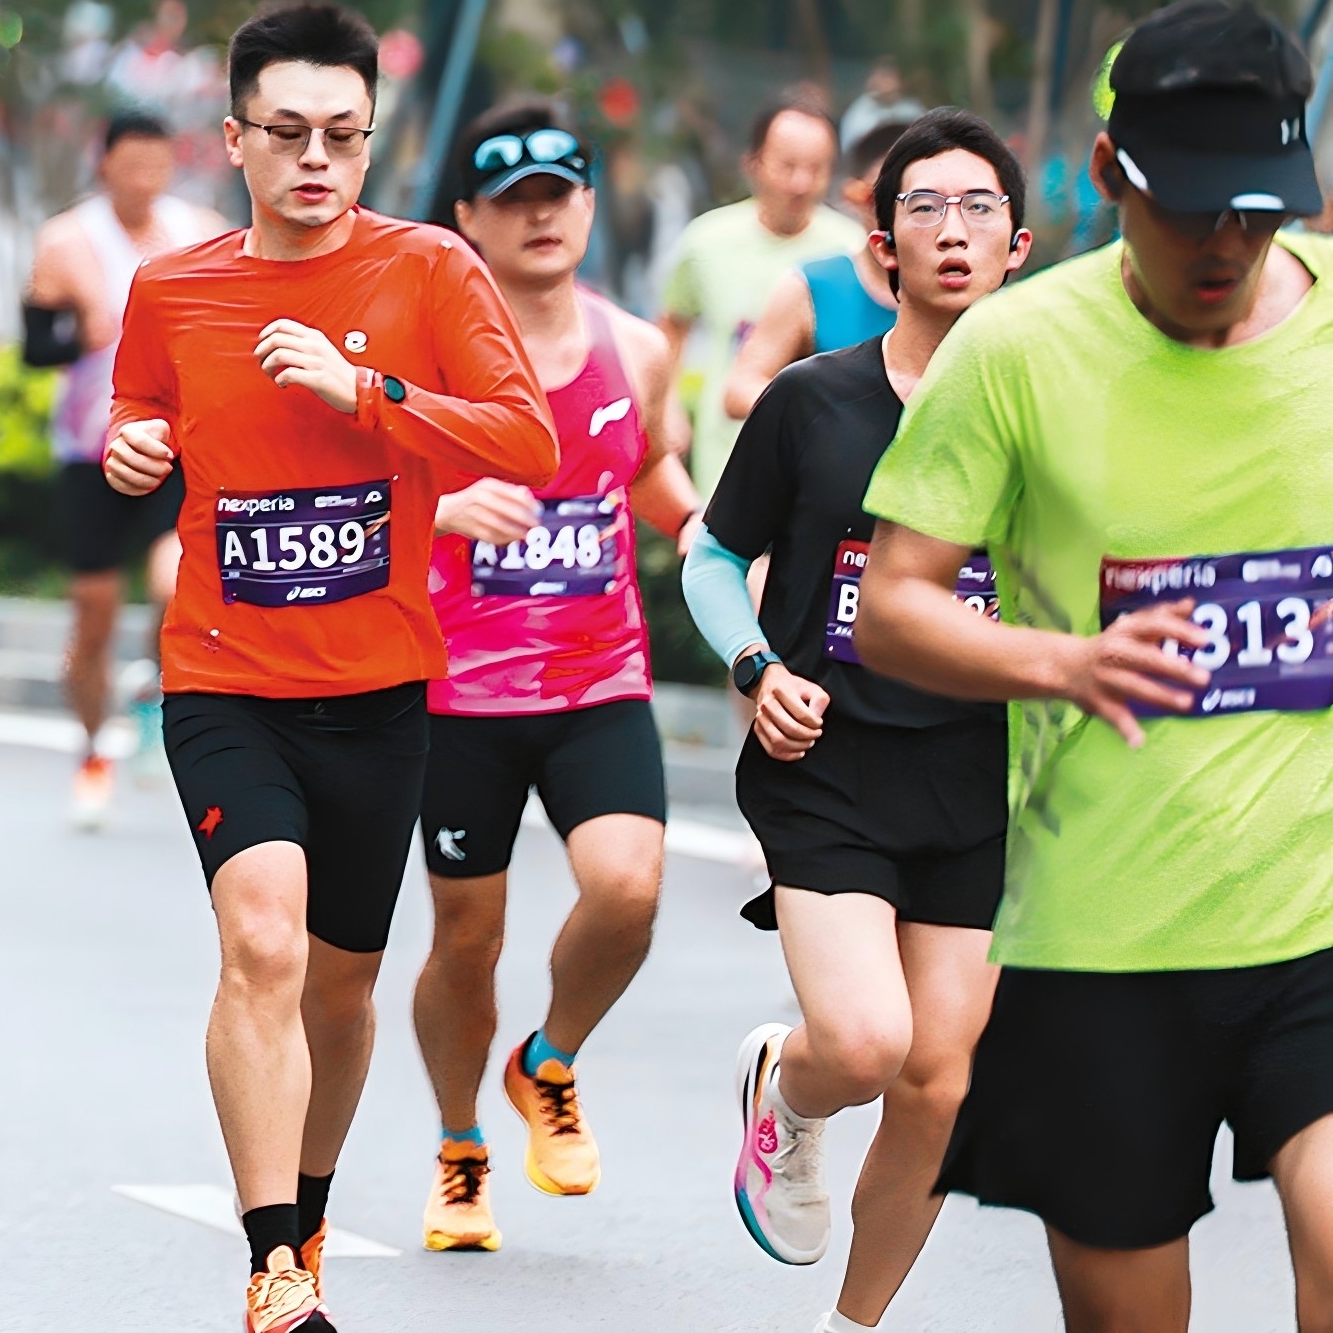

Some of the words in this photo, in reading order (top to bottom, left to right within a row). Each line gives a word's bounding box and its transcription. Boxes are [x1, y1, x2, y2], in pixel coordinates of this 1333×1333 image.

[217, 495, 295, 517] nexperia
[223, 521, 365, 571] A1589
[1119, 597, 1314, 670] 313
